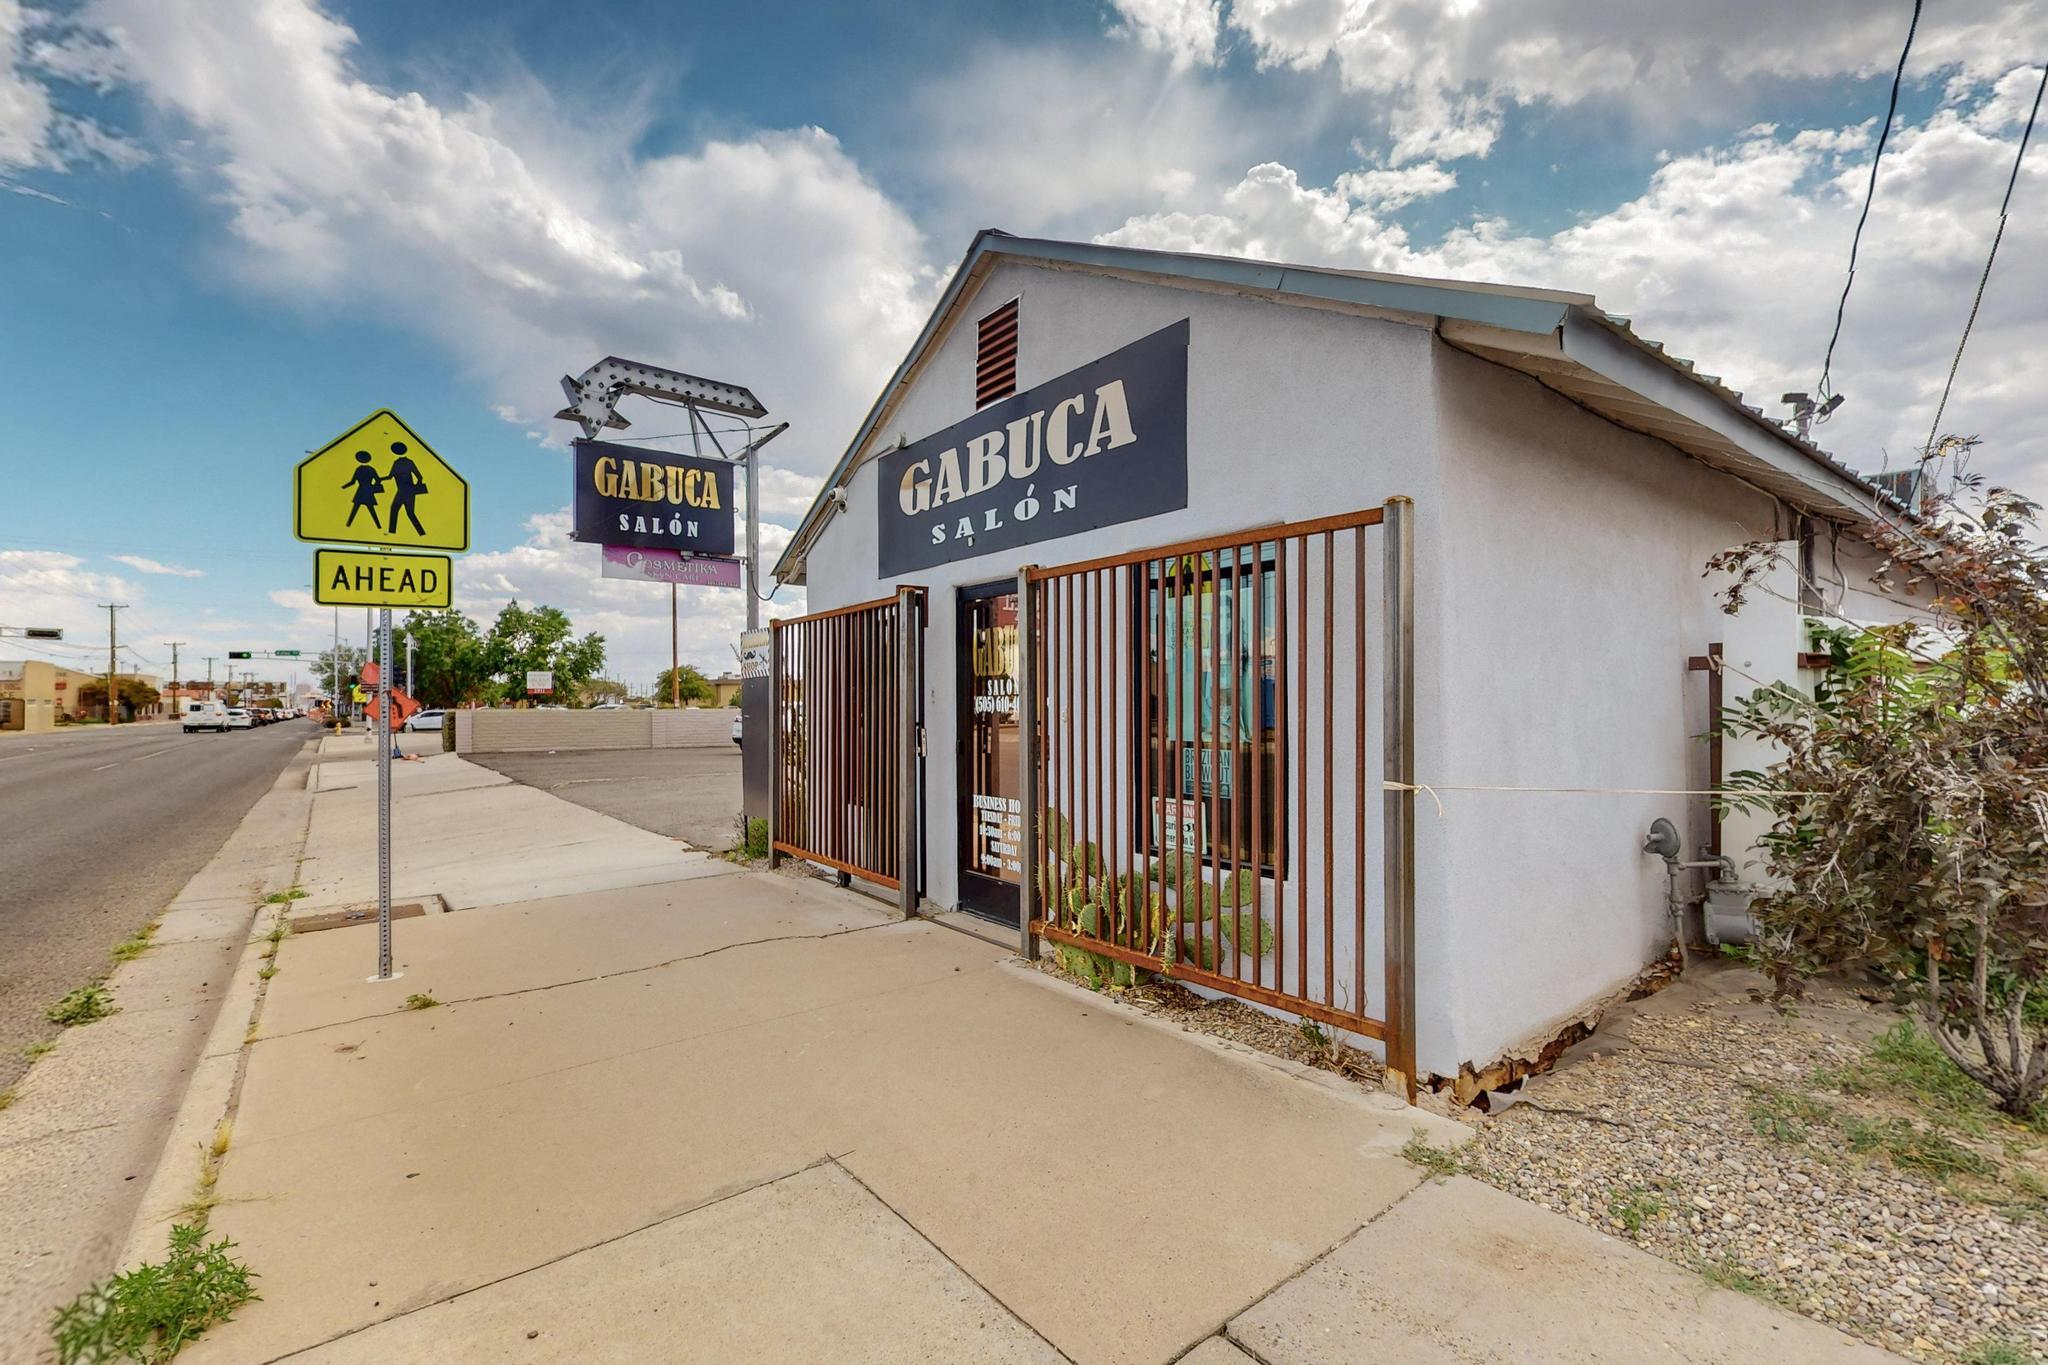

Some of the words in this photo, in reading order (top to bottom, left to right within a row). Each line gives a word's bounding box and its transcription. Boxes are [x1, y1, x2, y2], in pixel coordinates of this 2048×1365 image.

[899, 379, 1137, 516] GABUCA
[594, 456, 721, 510] GABUCA
[619, 512, 699, 538] SALÓN
[931, 483, 1078, 545] SALÓN
[331, 565, 437, 593] AHEAD
[976, 696, 995, 714] (505)
[973, 794, 1006, 811] BUSINESS
[1008, 799, 1021, 813] HO
[1008, 814, 1021, 826] FRID
[1008, 829, 1021, 841] 6:00
[991, 841, 1017, 856] SATURDAY
